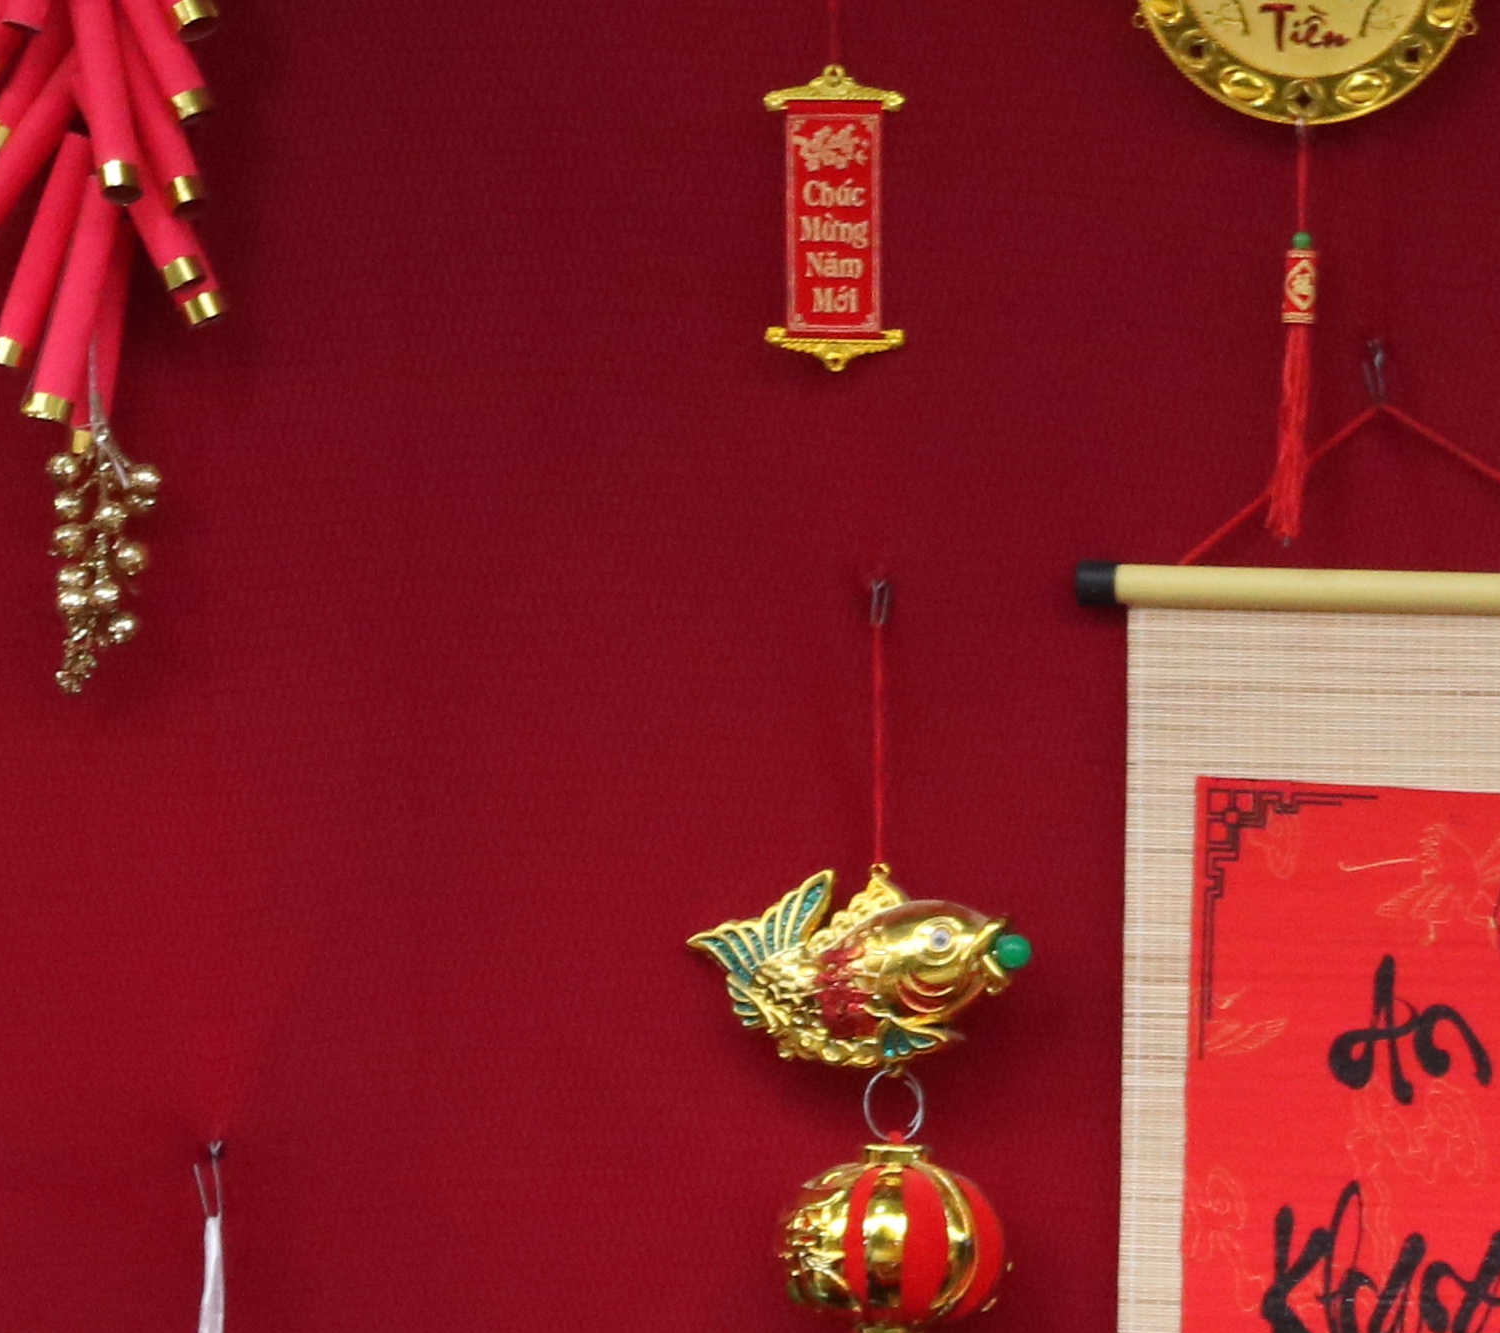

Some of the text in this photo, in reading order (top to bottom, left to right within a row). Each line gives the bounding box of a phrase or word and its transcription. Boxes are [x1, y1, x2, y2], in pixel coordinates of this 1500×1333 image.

[1259, 3, 1351, 52] Tiền
[802, 178, 866, 208] Chúc
[799, 212, 870, 249] Mừng
[804, 252, 865, 279] Năm
[812, 285, 860, 313] Mới
[1327, 954, 1492, 1105] An
